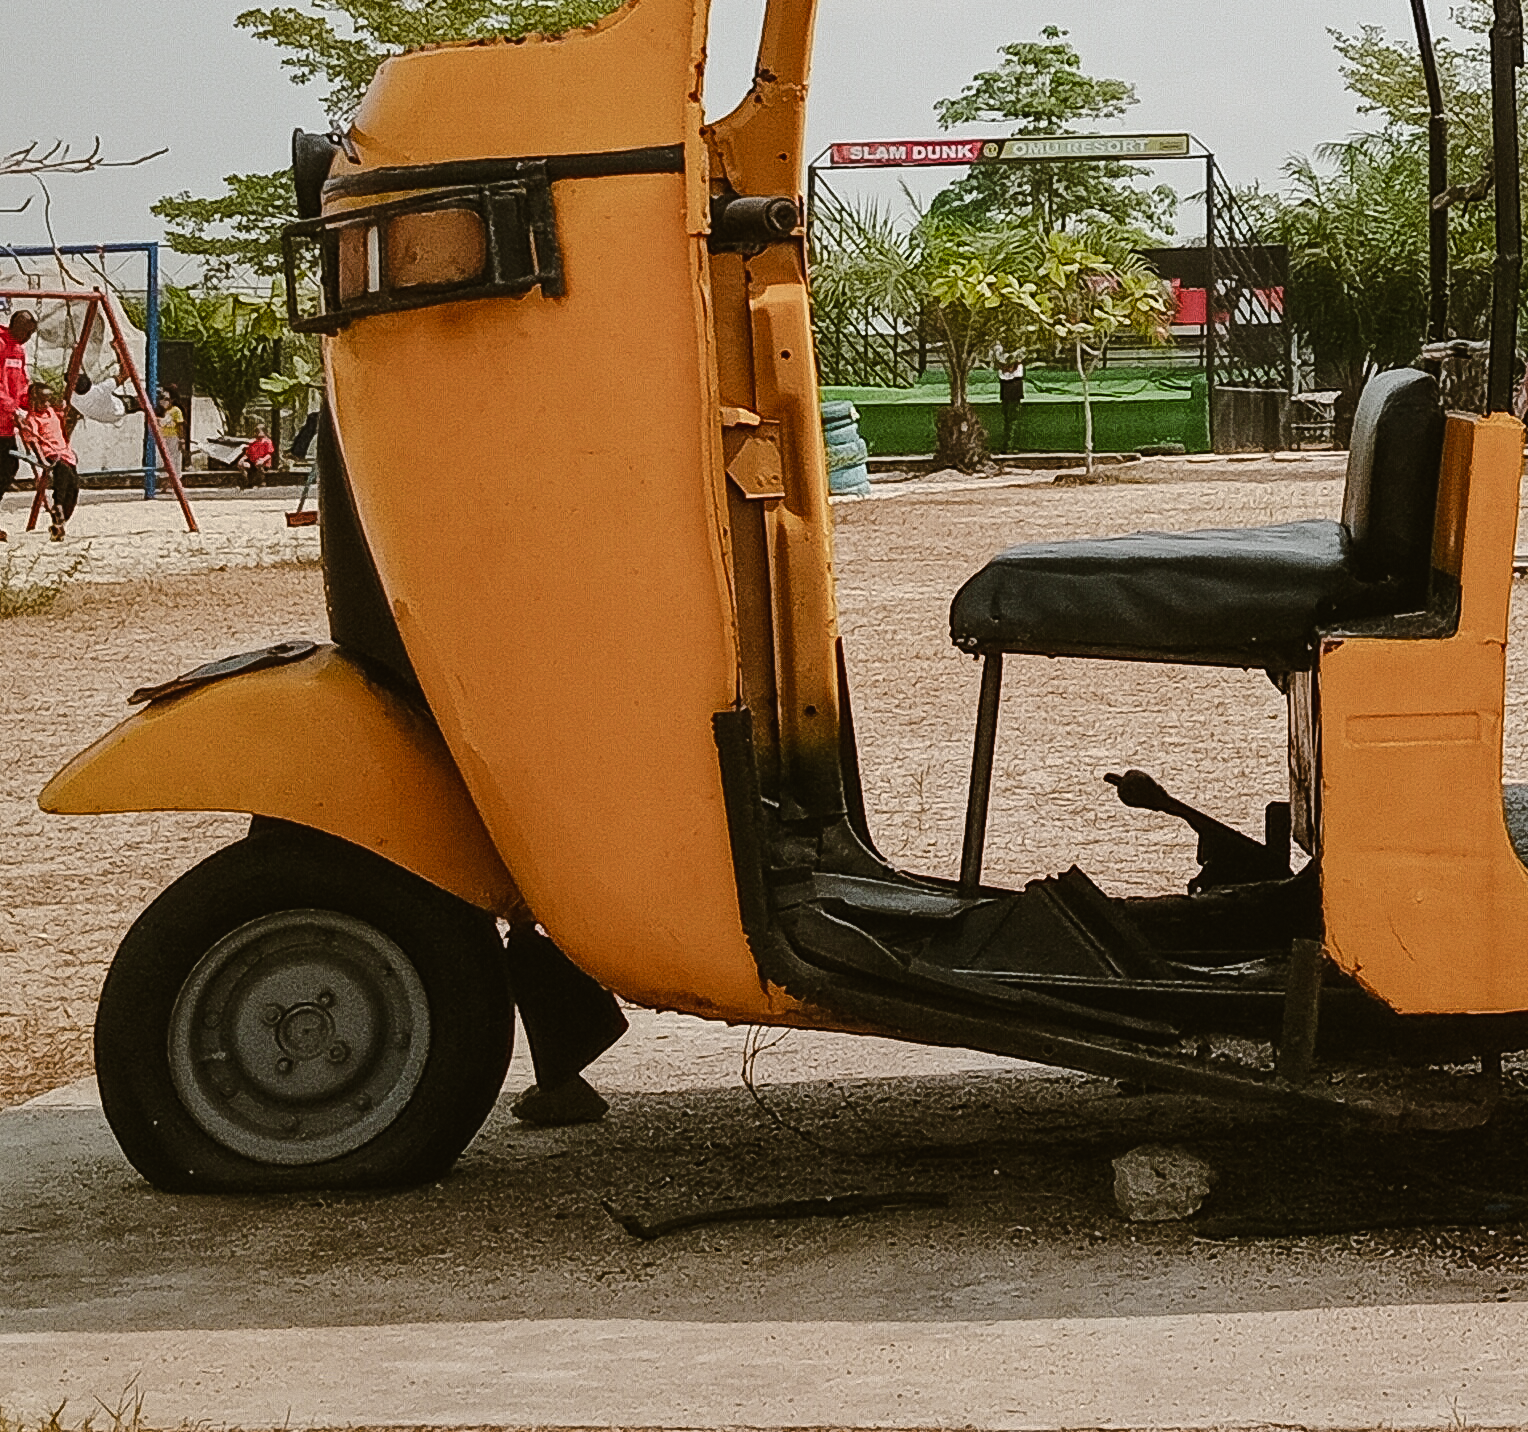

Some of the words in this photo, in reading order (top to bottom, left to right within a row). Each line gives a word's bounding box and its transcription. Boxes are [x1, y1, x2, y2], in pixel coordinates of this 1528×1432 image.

[850, 145, 907, 160] SLAM
[912, 144, 974, 159] DUNK
[1012, 142, 1059, 156] OMU
[1066, 138, 1149, 154] RESORT
